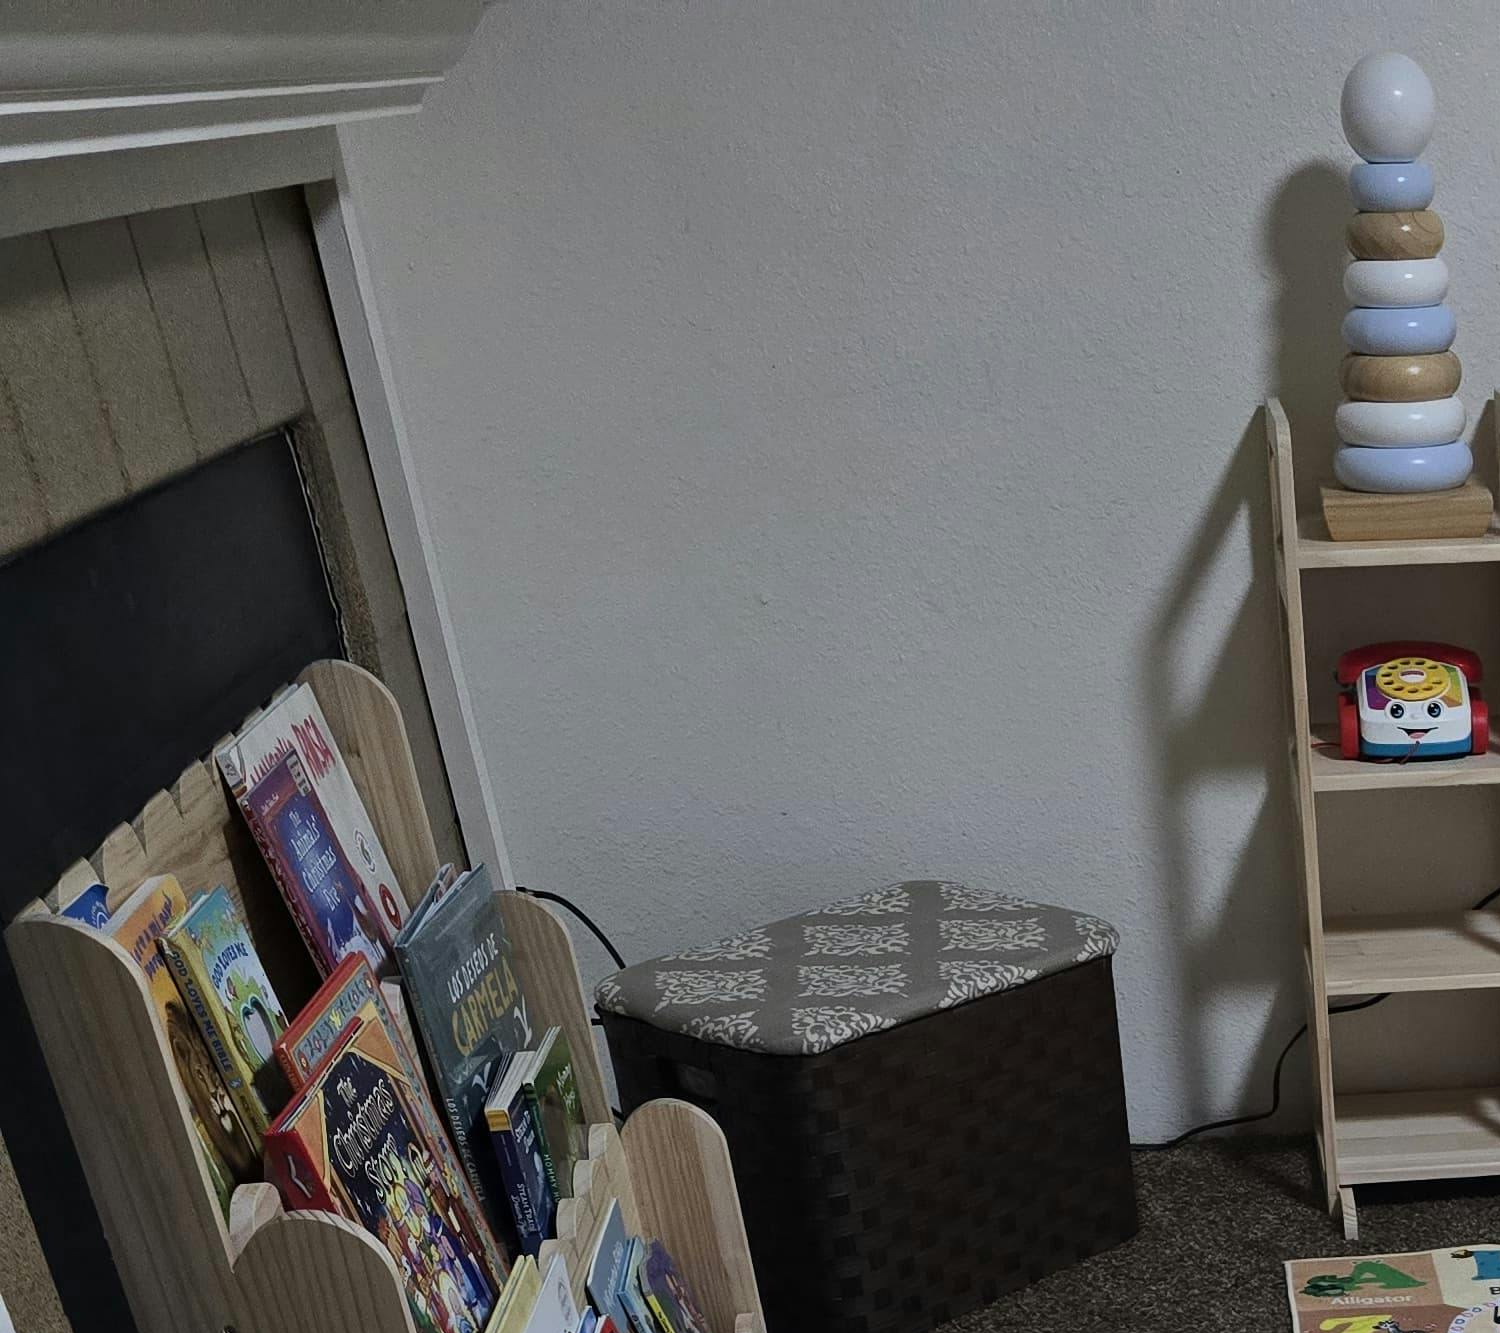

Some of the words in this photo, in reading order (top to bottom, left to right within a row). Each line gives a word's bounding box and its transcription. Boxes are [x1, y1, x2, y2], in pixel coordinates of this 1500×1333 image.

[289, 809, 302, 827] The
[302, 845, 337, 894] Christmas
[322, 886, 341, 911] Eve
[447, 969, 463, 1004] LOS
[461, 943, 489, 991] DESEOS
[486, 932, 499, 961] DE
[170, 951, 188, 977] GOD
[184, 978, 207, 1019] LOVES
[203, 1019, 218, 1039] ME
[212, 1039, 234, 1073] BIBLE
[452, 955, 519, 1056] CARMELA
[336, 1077, 357, 1107] The
[447, 1098, 458, 1114] LOS
[334, 1078, 395, 1178] Christmas
[451, 1114, 468, 1147] DESEOS
[365, 1132, 399, 1204] Story
[543, 1153, 560, 1187] MOMMY
[1350, 1260, 1428, 1291] A
[1330, 1294, 1413, 1306] Alligator
